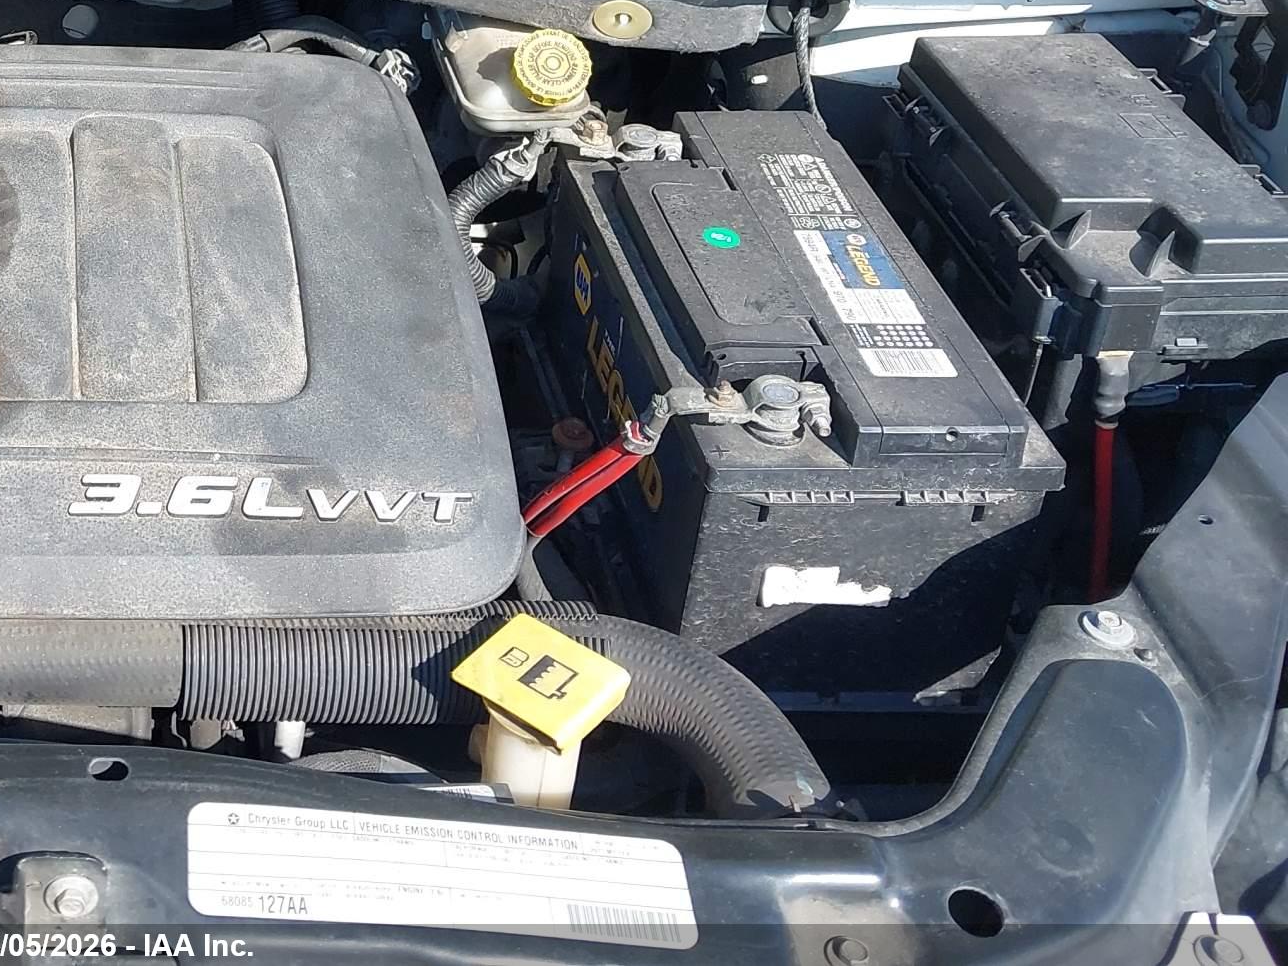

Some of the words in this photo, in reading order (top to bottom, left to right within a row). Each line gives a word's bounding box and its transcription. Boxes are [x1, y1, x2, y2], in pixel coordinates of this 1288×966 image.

[248, 812, 291, 827] Chrysler
[295, 815, 326, 830] Group
[330, 819, 350, 831] LLC
[359, 821, 401, 835] VEHICLE
[405, 825, 454, 839] EMISSION
[458, 830, 504, 844] CONTROL
[507, 834, 578, 851] INFORMATION
[258, 893, 309, 916] 127AA
